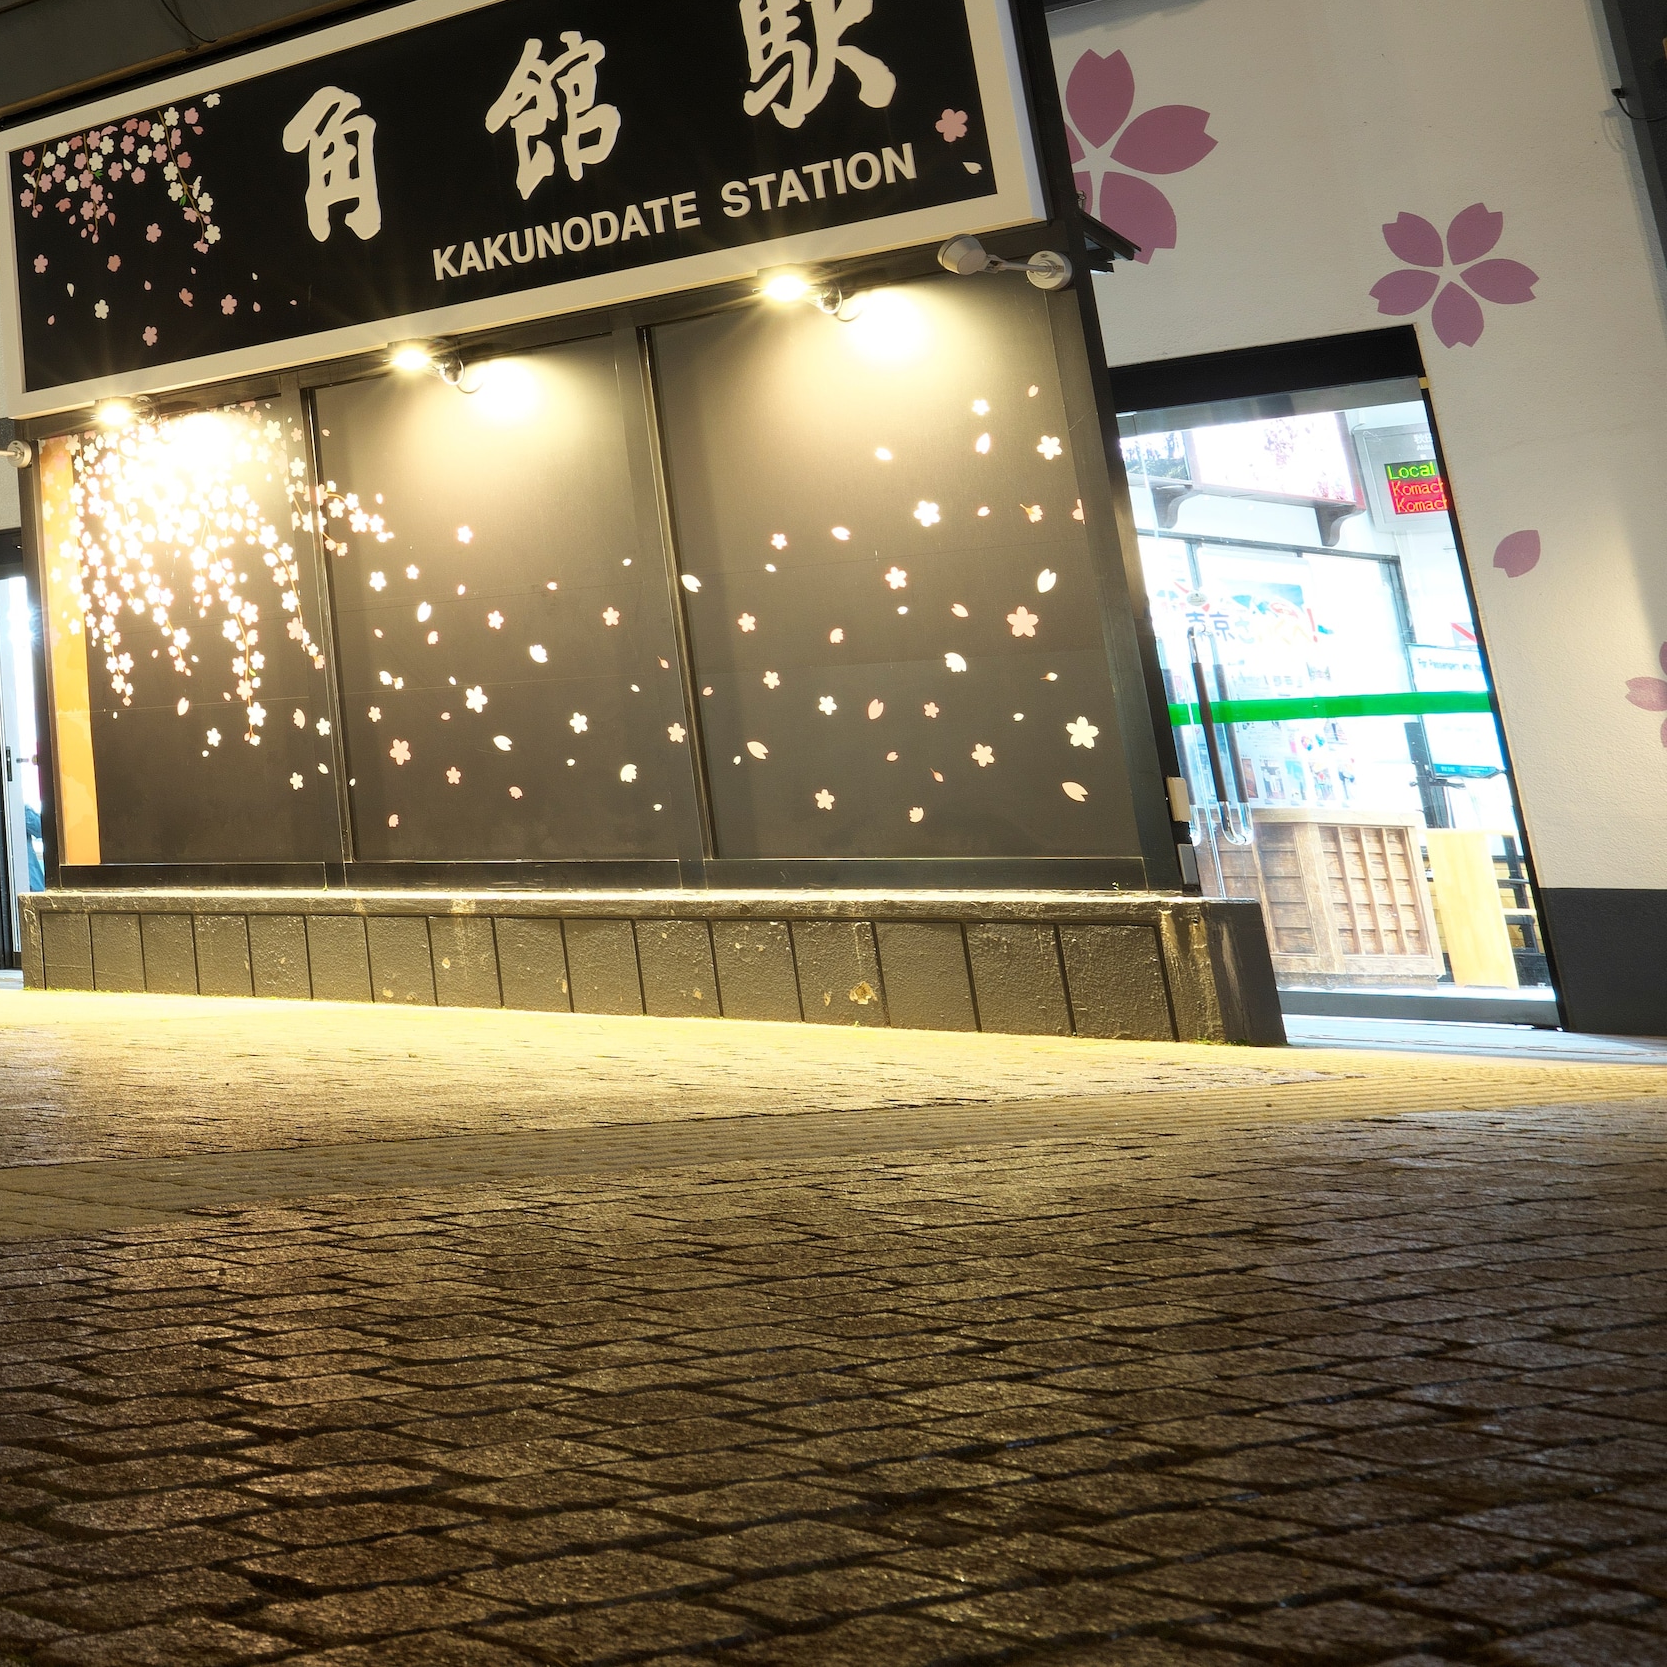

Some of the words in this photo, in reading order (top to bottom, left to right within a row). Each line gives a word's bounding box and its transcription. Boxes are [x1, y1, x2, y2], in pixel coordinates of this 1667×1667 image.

[432, 191, 703, 282] KAKUNODATE
[721, 142, 917, 219] STATION
[1387, 461, 1435, 479] Local
